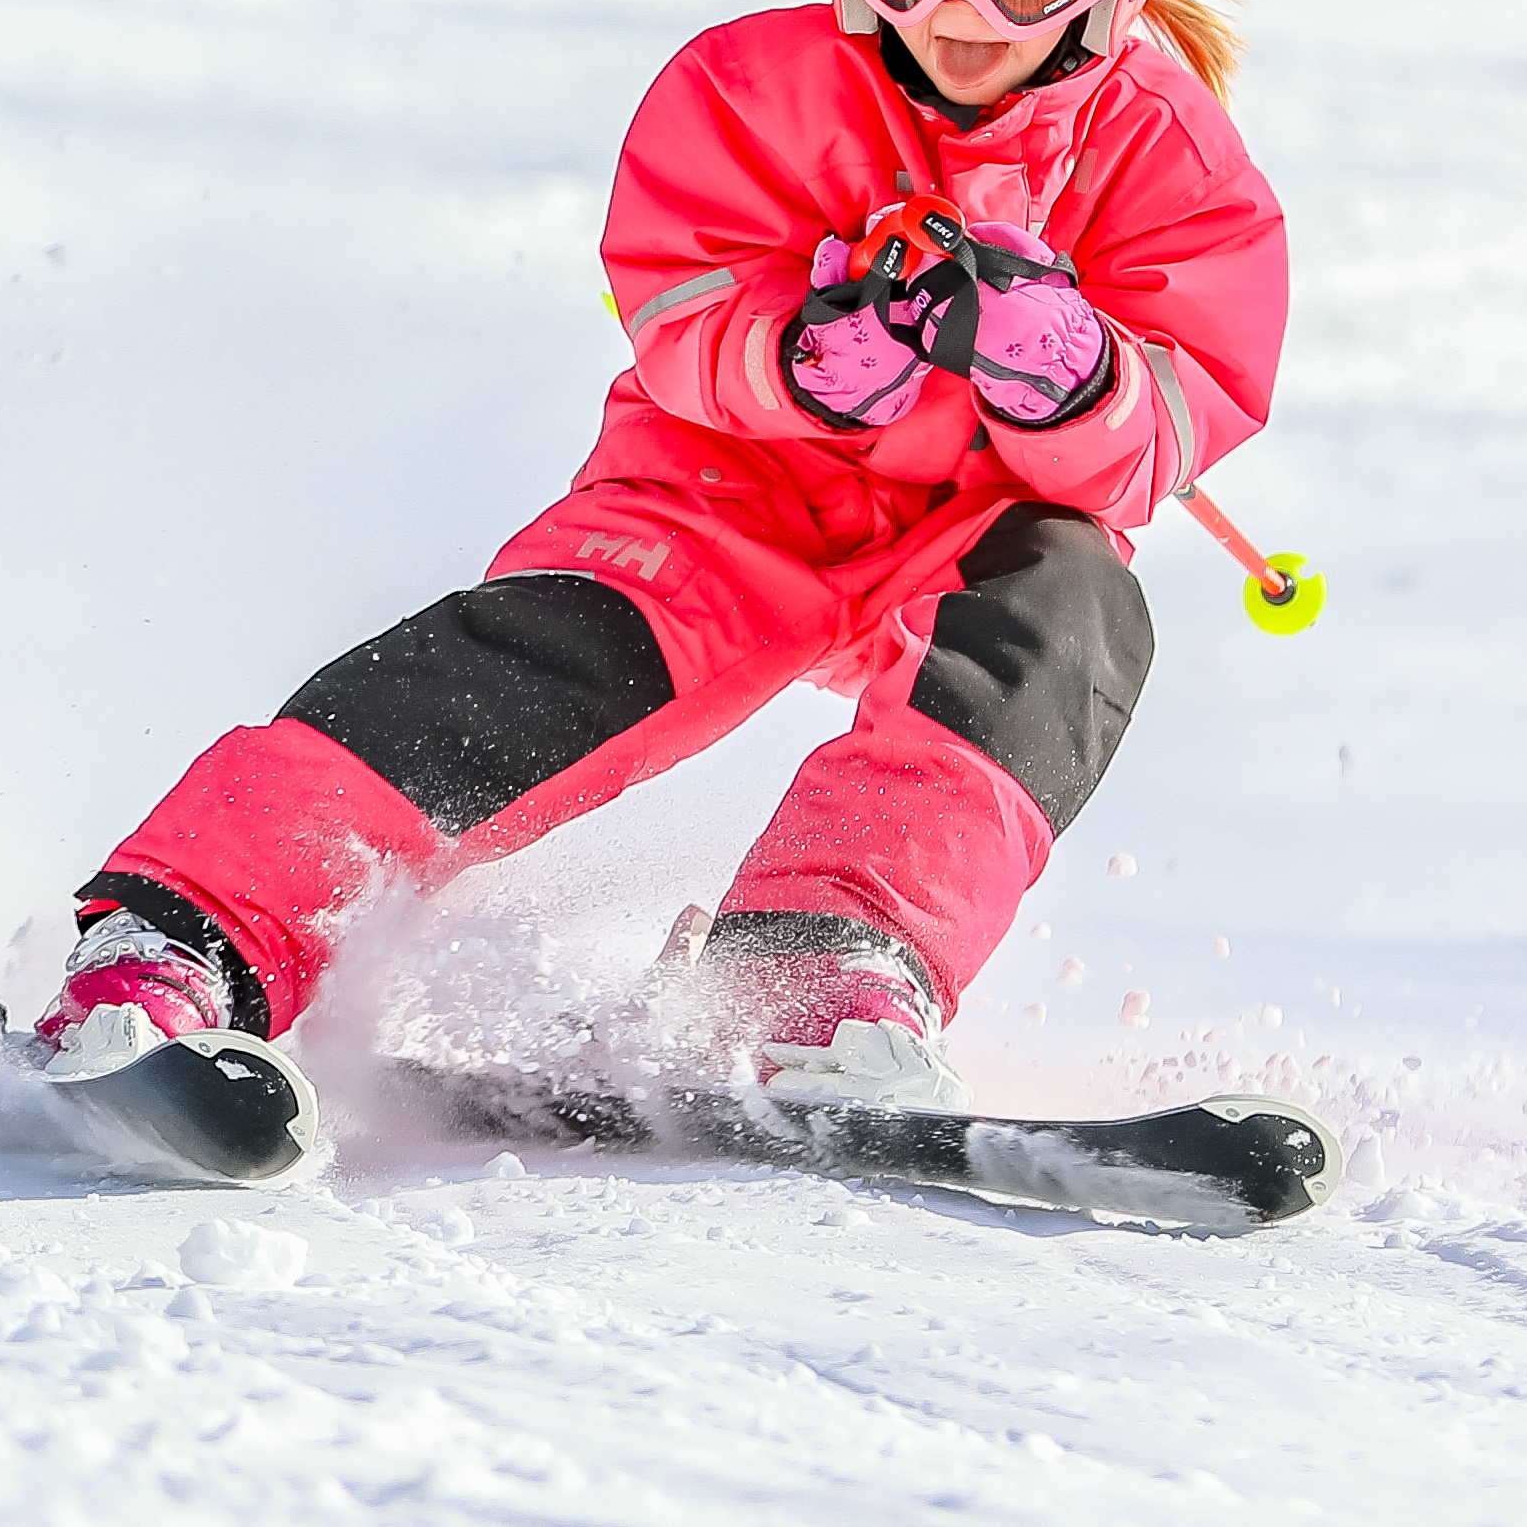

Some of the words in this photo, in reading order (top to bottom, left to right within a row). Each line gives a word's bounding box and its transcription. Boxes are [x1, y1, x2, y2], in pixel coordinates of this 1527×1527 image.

[925, 217, 954, 239] LEKI
[883, 240, 902, 273] LEKI
[575, 531, 672, 582] HH
